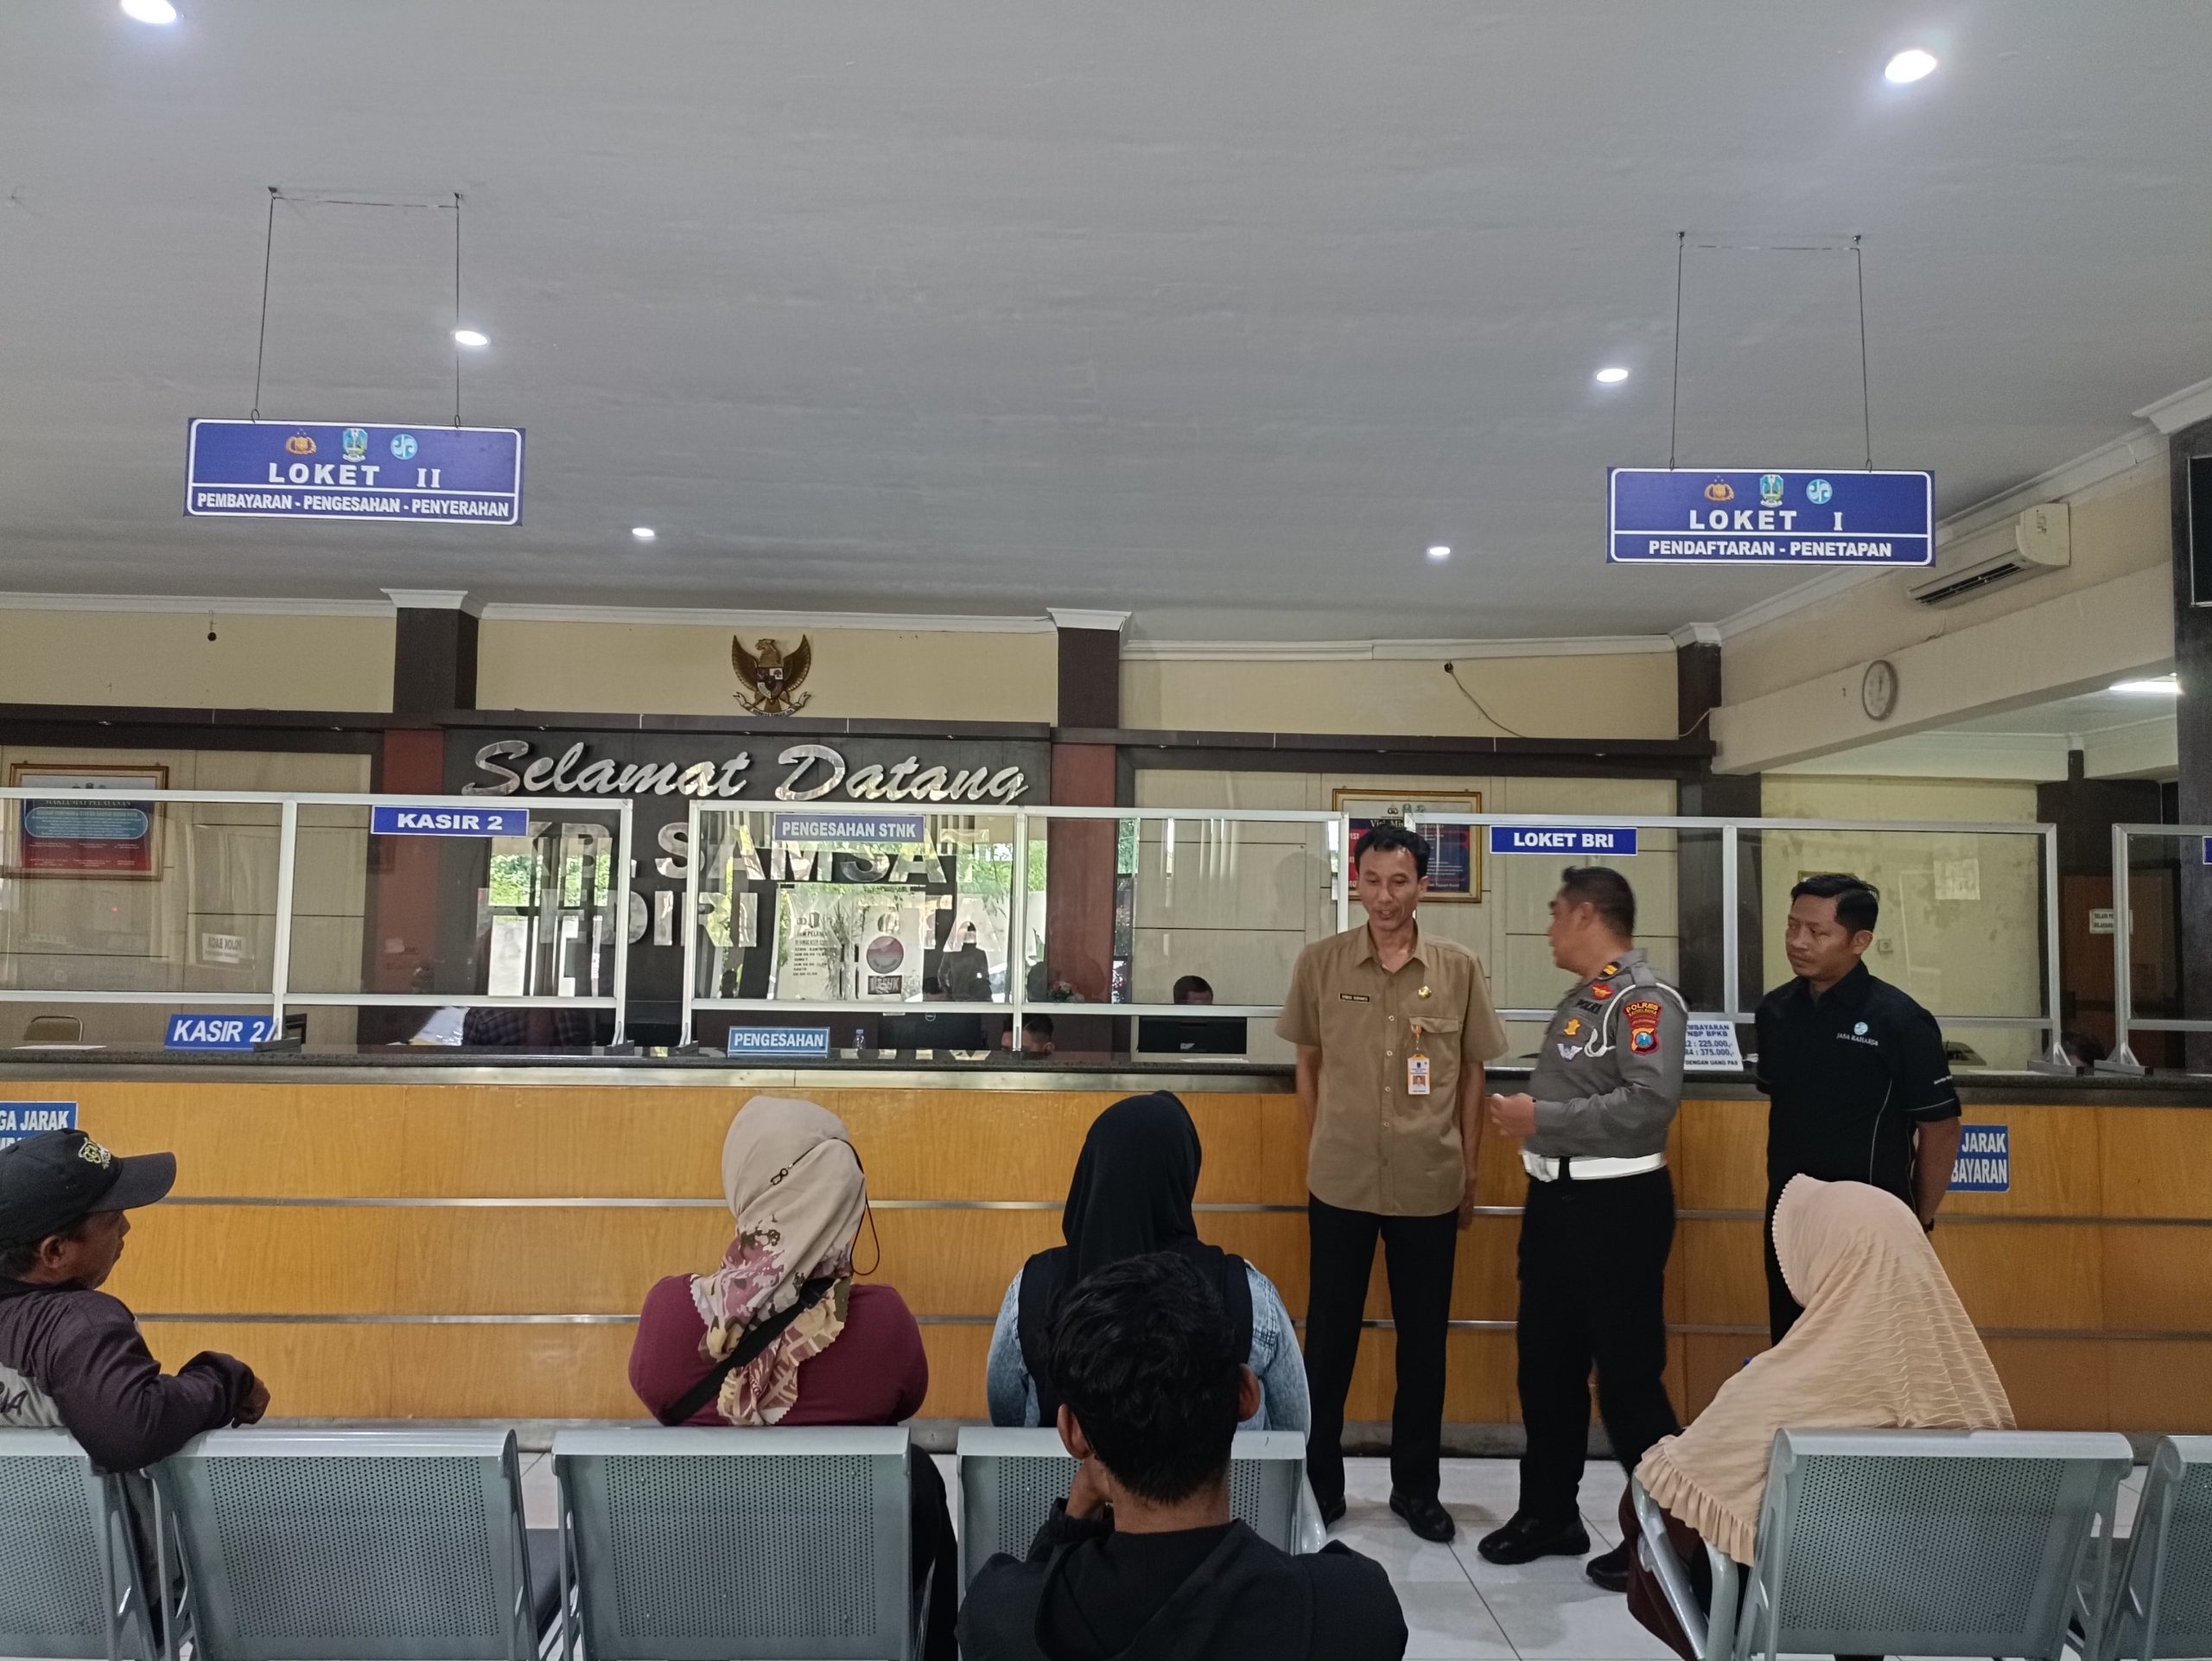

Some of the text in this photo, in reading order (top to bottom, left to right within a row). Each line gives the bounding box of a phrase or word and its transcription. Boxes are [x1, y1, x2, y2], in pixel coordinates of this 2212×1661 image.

[269, 462, 442, 488] LOKET II
[197, 493, 292, 510] PEMBAYARAN
[303, 495, 401, 514] PENGESAHAN
[412, 500, 509, 518] PENYERAHAN
[1689, 509, 1843, 531] LOKET I
[1649, 540, 1775, 556] PENDAFTARAN
[1789, 542, 1891, 557] PENETAPAN
[461, 740, 1029, 805] Selamat Datang
[397, 813, 503, 830] KASIR 2
[782, 822, 917, 838] PENGESAHAN STNK
[1513, 831, 1614, 849] LOKET BRI
[173, 1020, 266, 1043] KASIR 2
[734, 1033, 823, 1047] PENGESAHAN
[20, 1110, 69, 1131] JARAK
[1961, 1132, 2006, 1153] JARAK
